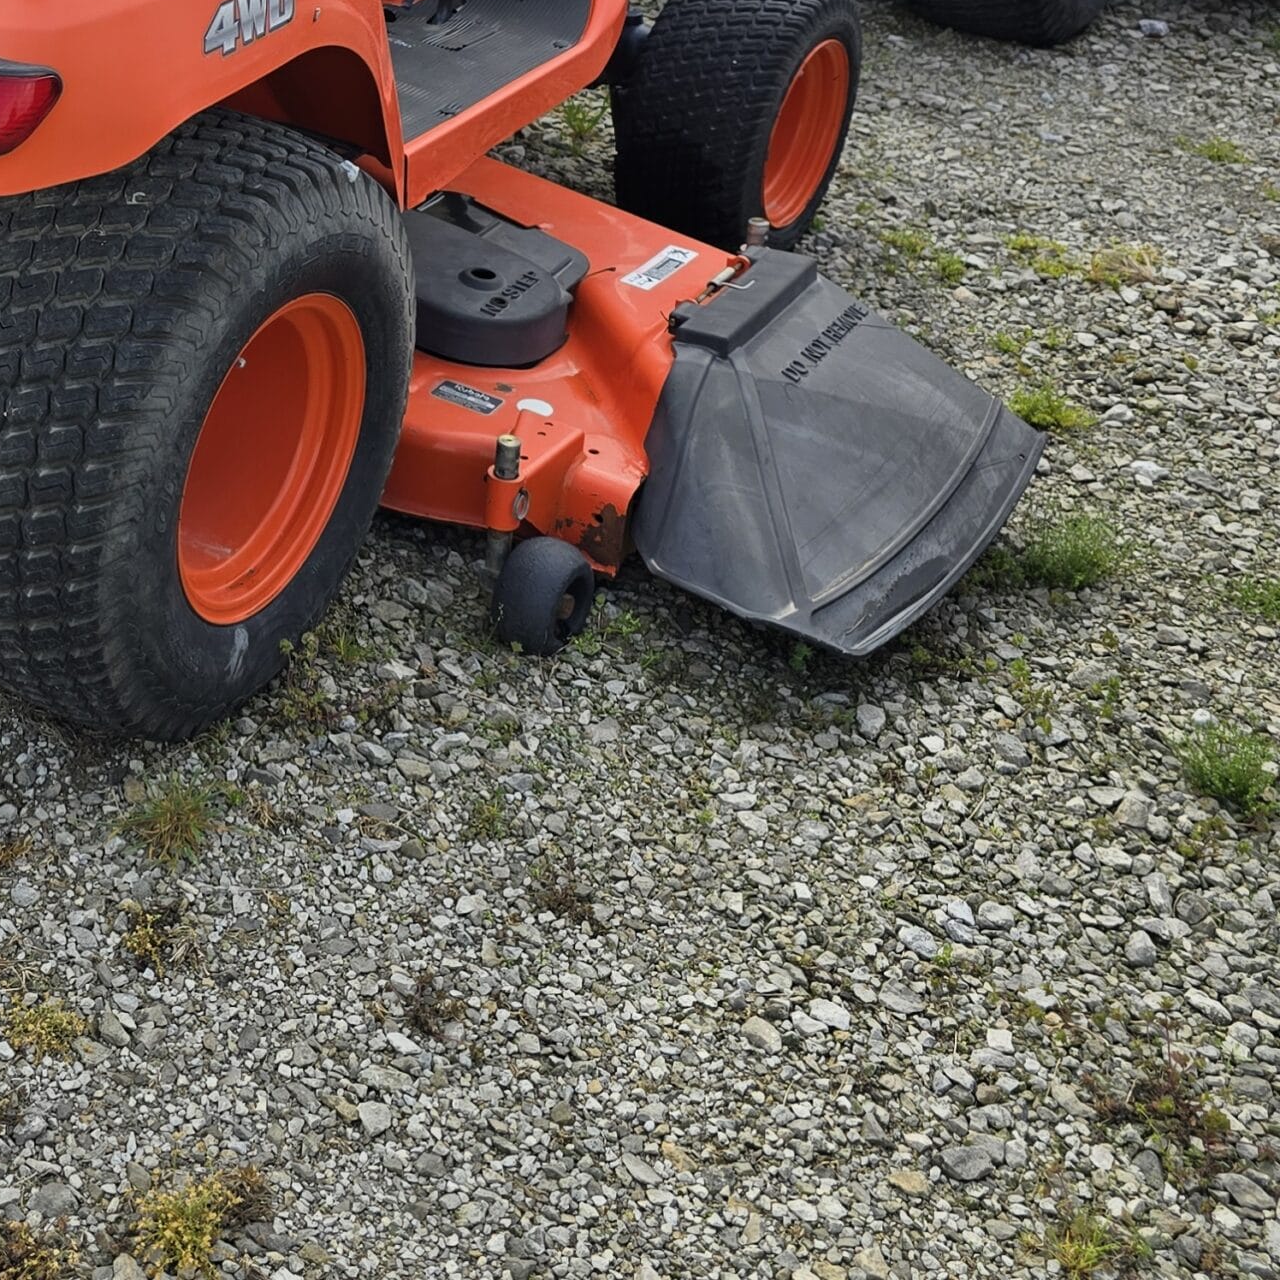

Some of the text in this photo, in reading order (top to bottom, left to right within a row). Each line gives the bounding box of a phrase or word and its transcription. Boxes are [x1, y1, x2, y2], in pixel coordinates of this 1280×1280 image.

[480, 297, 509, 317] NO
[781, 304, 869, 383] DO NOT REMOVE
[454, 384, 490, 401] Kubota
